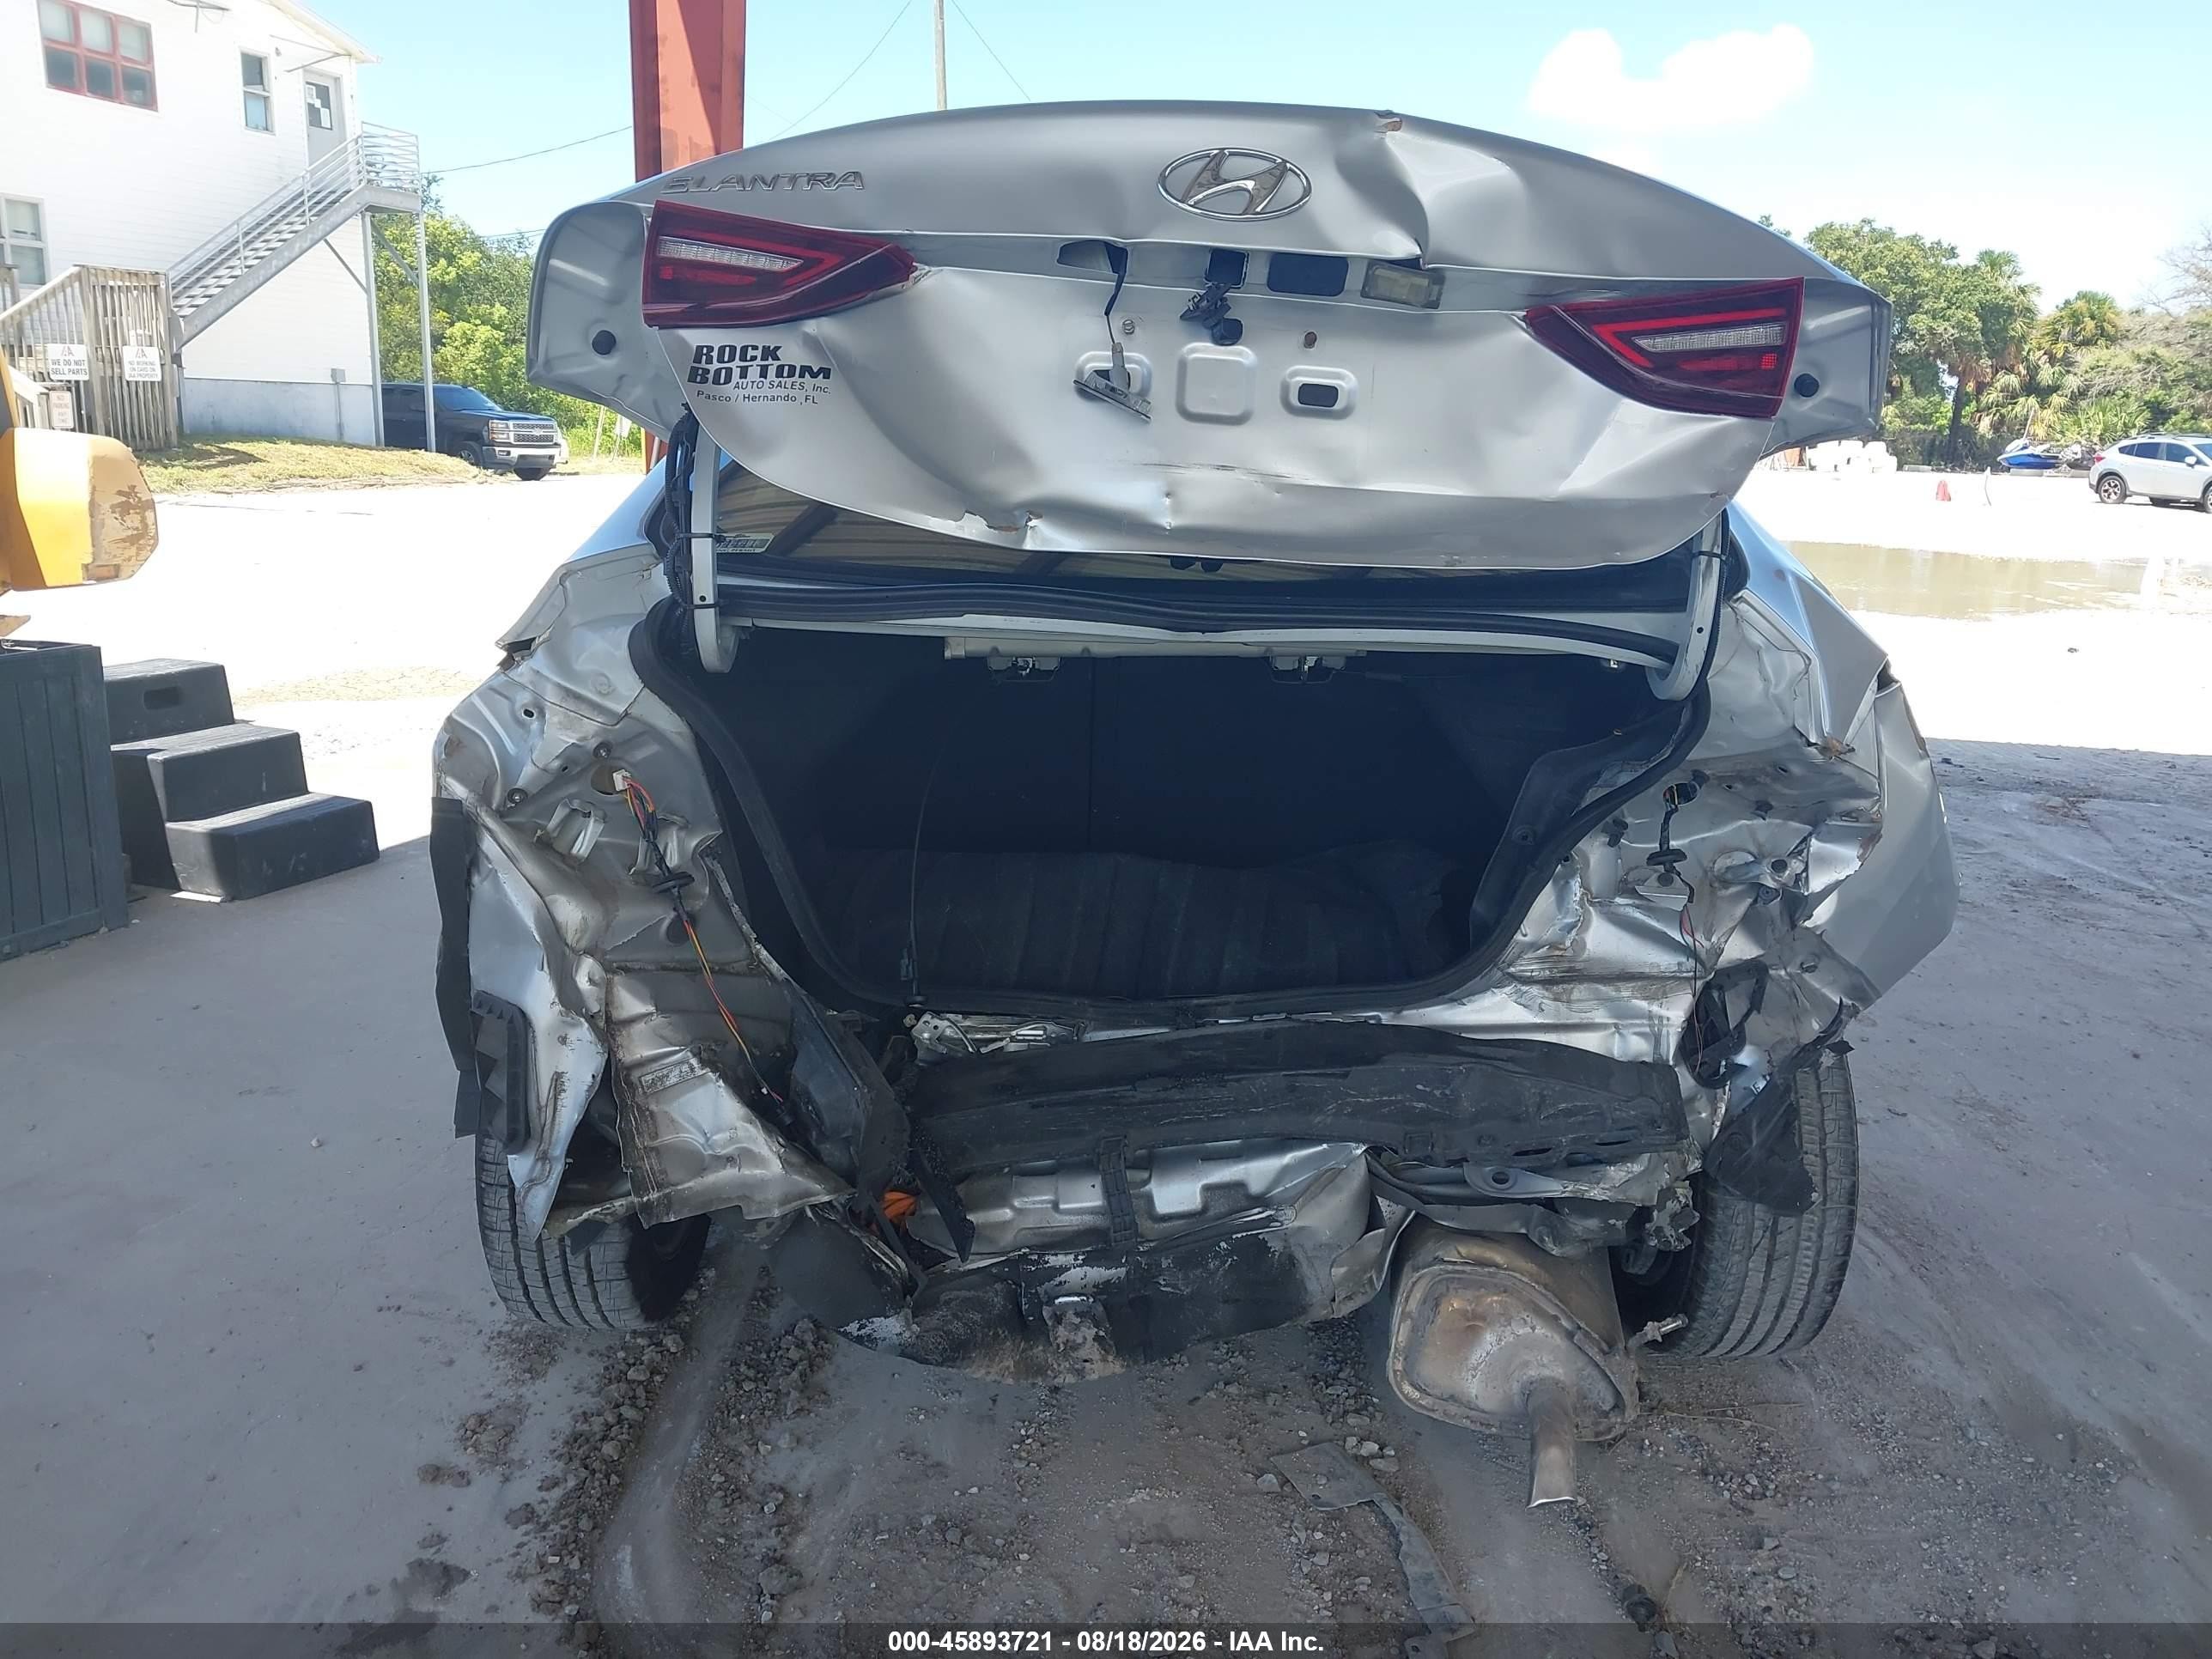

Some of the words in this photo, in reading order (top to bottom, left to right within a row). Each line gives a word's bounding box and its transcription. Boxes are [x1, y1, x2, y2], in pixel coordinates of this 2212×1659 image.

[659, 171, 865, 194] ELANTRA
[692, 344, 783, 365] ROCK
[51, 358, 61, 367] WE
[68, 368, 88, 376] PARTS
[687, 364, 832, 386] BOTTOM
[732, 380, 765, 391] AUTO
[768, 380, 809, 392] SALES,
[811, 383, 832, 395] Inc.
[696, 390, 732, 403] Pasco
[734, 394, 739, 403] /
